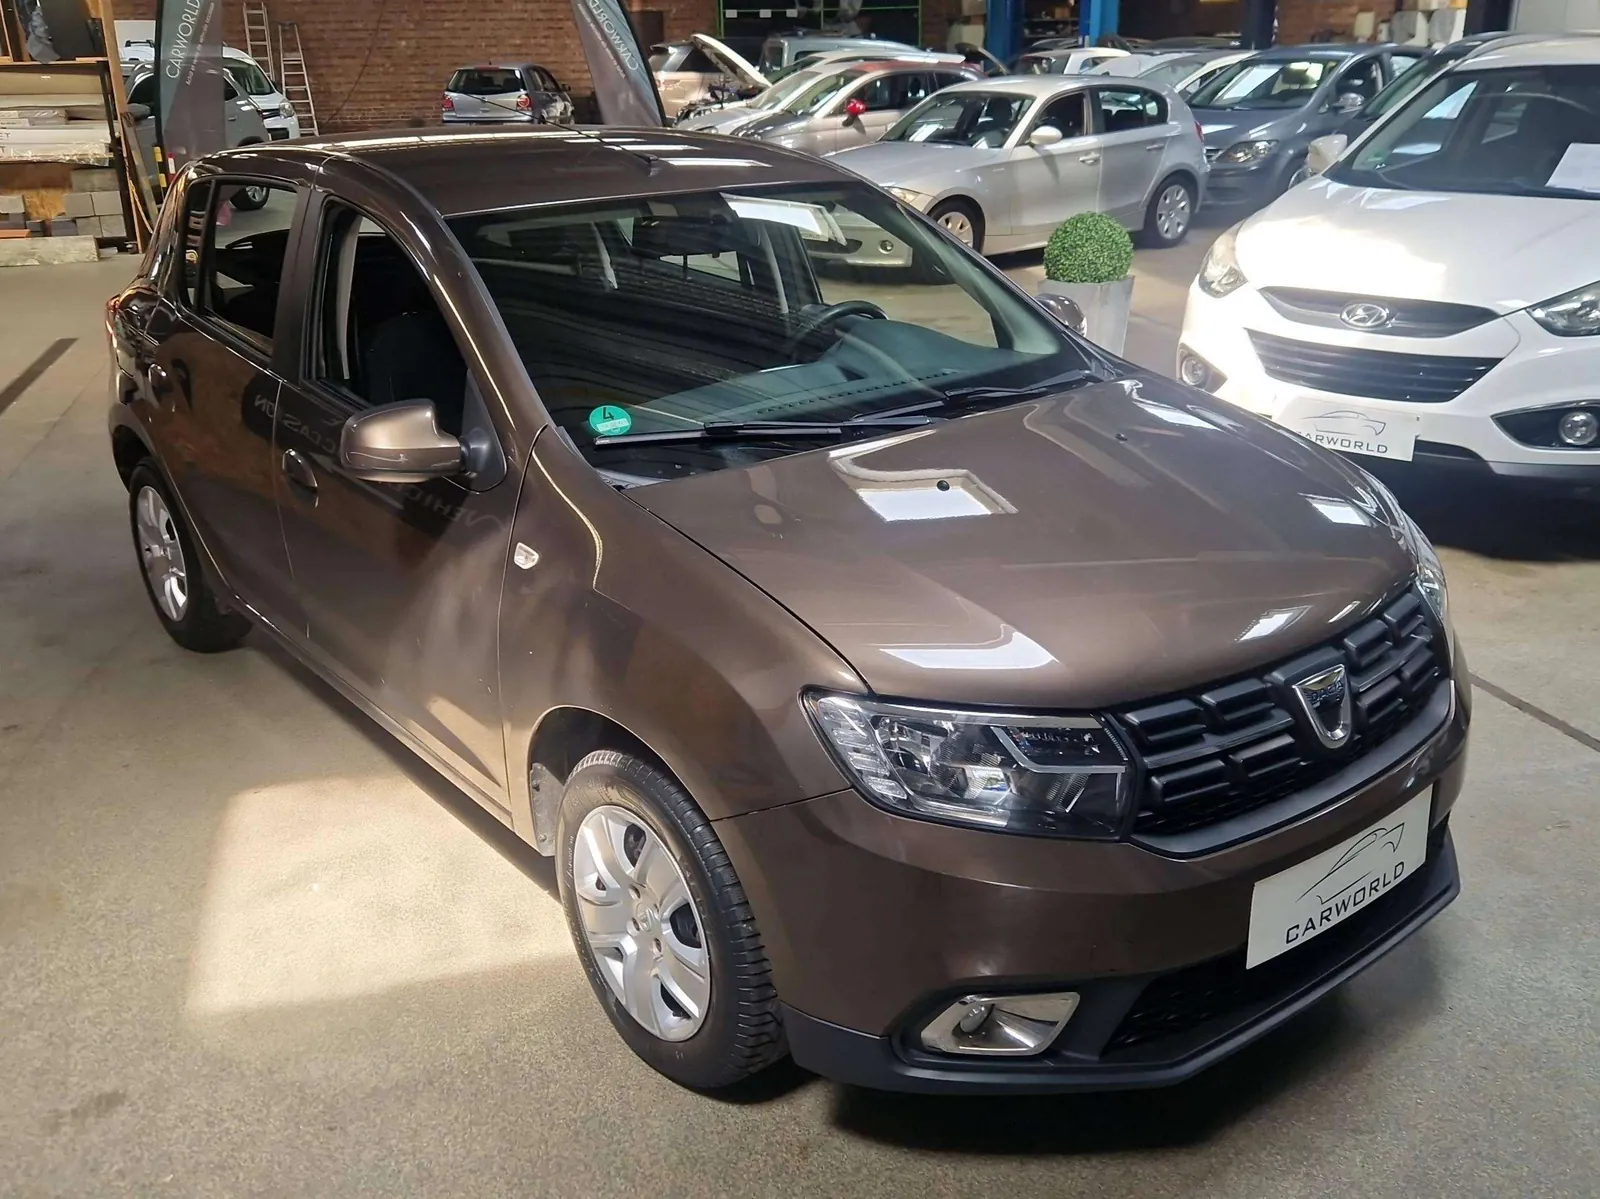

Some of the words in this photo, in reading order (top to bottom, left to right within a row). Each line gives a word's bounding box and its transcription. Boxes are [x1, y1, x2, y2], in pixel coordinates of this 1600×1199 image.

[602, 406, 615, 420] 4
[1297, 430, 1388, 454] ARWORLD
[1286, 861, 1405, 945] CARWORLD
